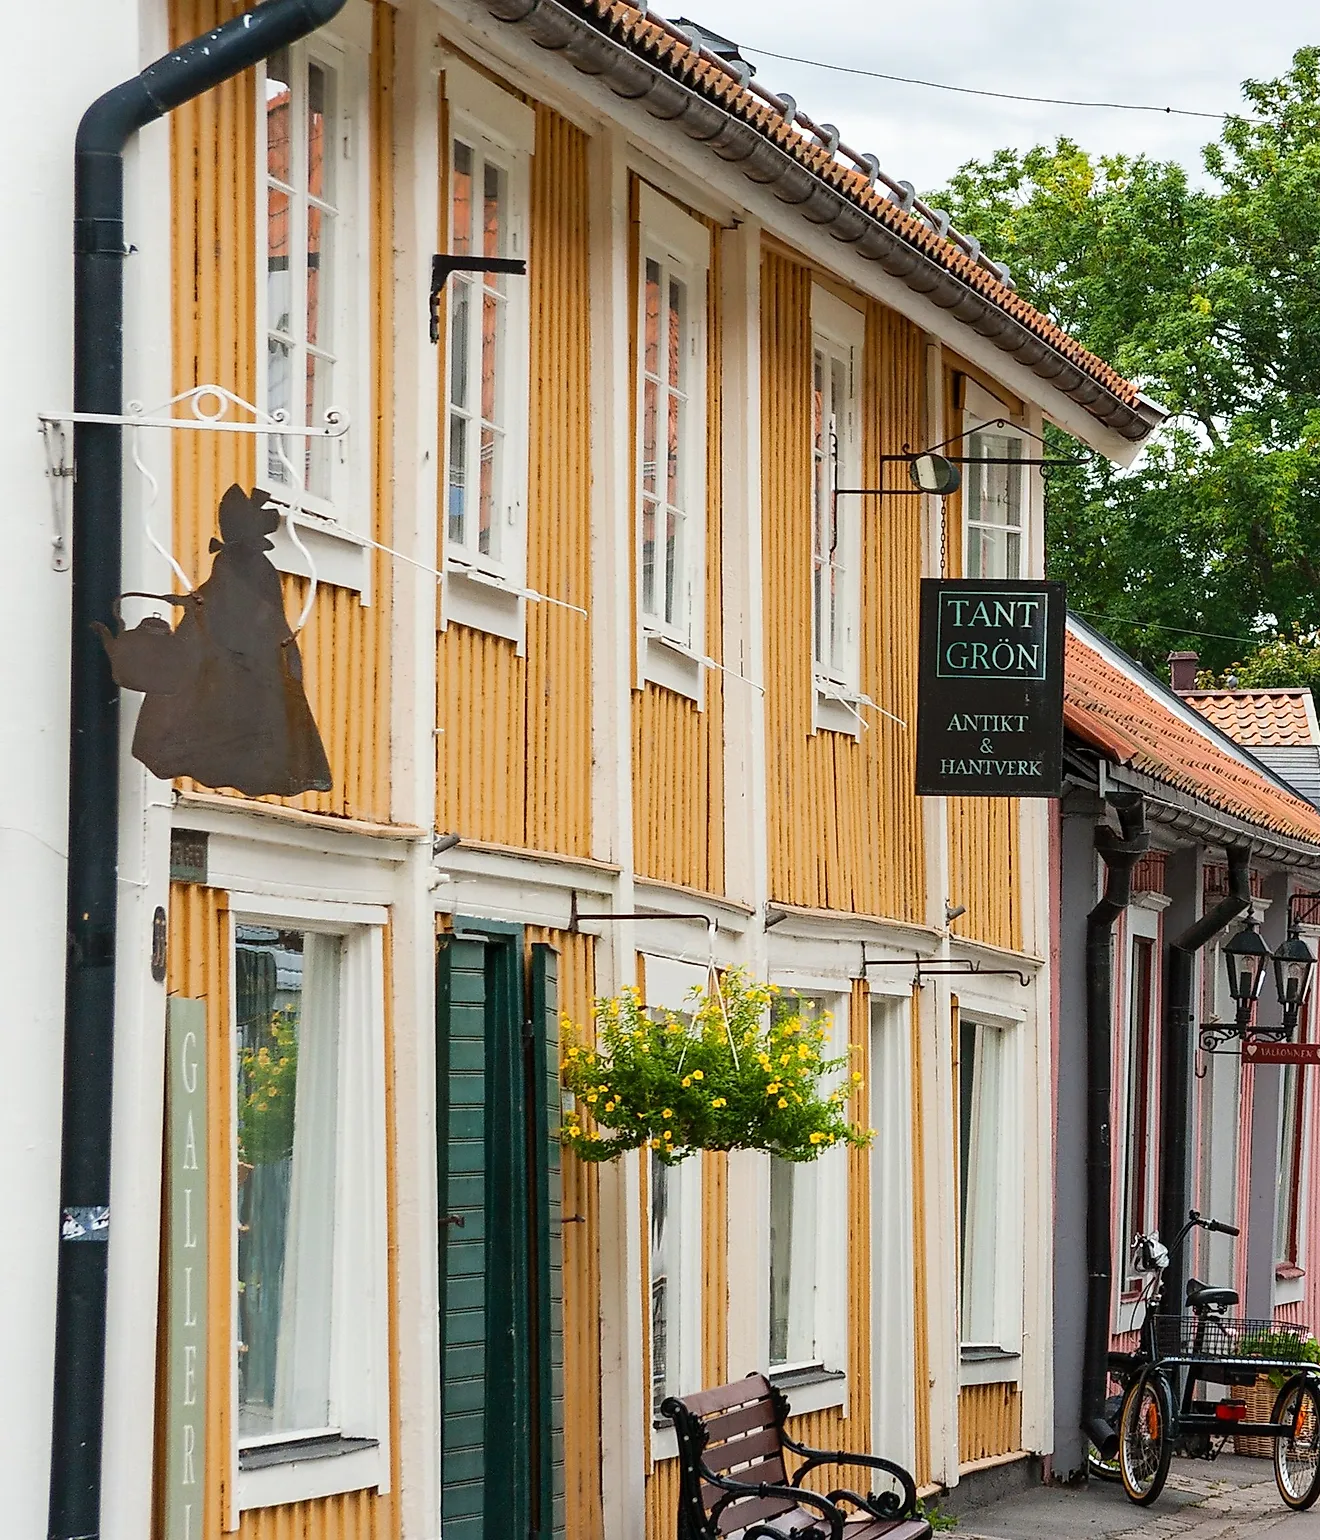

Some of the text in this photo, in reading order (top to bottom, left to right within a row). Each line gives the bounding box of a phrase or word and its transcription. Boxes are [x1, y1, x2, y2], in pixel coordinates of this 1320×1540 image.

[947, 600, 1039, 629] TANT
[946, 638, 1040, 671] GRÖN
[946, 713, 1029, 733] ANTIKT
[979, 737, 994, 754] &
[939, 759, 1042, 777] HANTVERK
